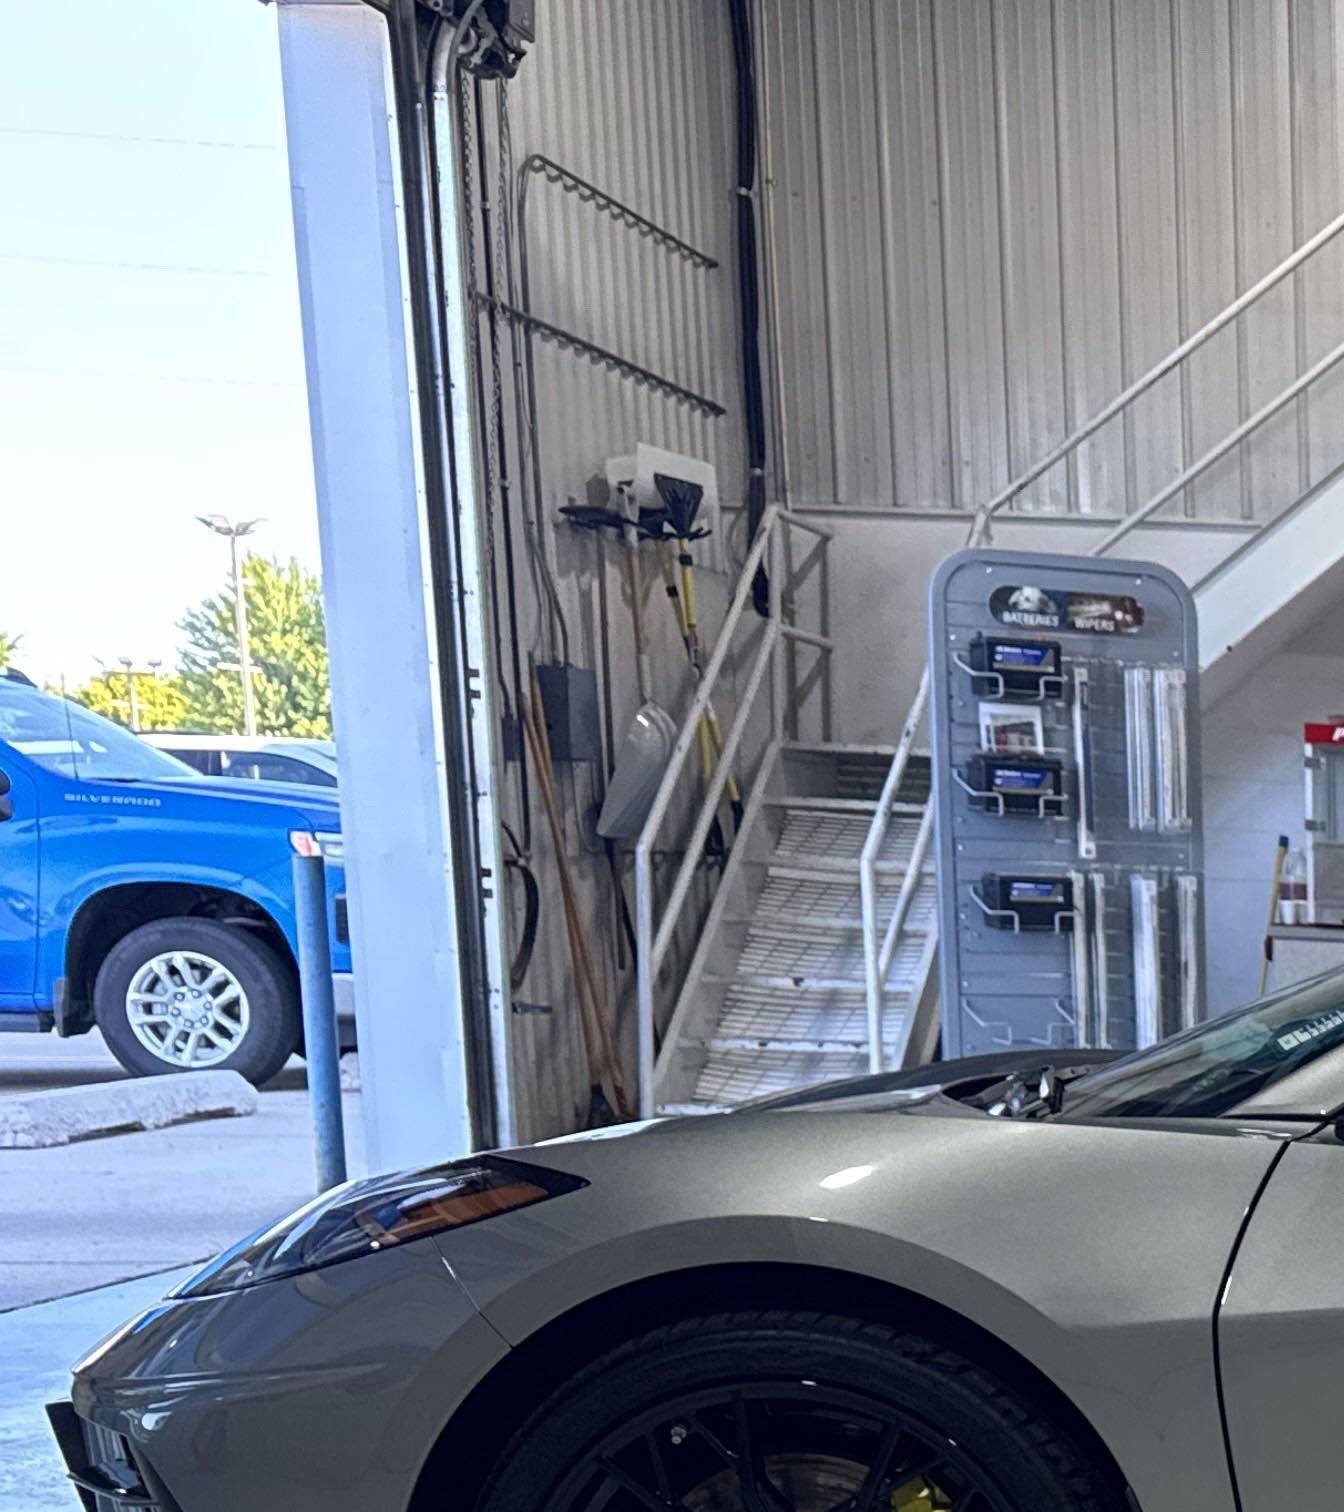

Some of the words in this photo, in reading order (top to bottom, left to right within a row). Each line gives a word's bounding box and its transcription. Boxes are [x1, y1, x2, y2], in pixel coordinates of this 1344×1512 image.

[1002, 611, 1059, 627] BATTERIES
[1074, 617, 1115, 632] WIPERS
[64, 793, 161, 807] SILVERADO
